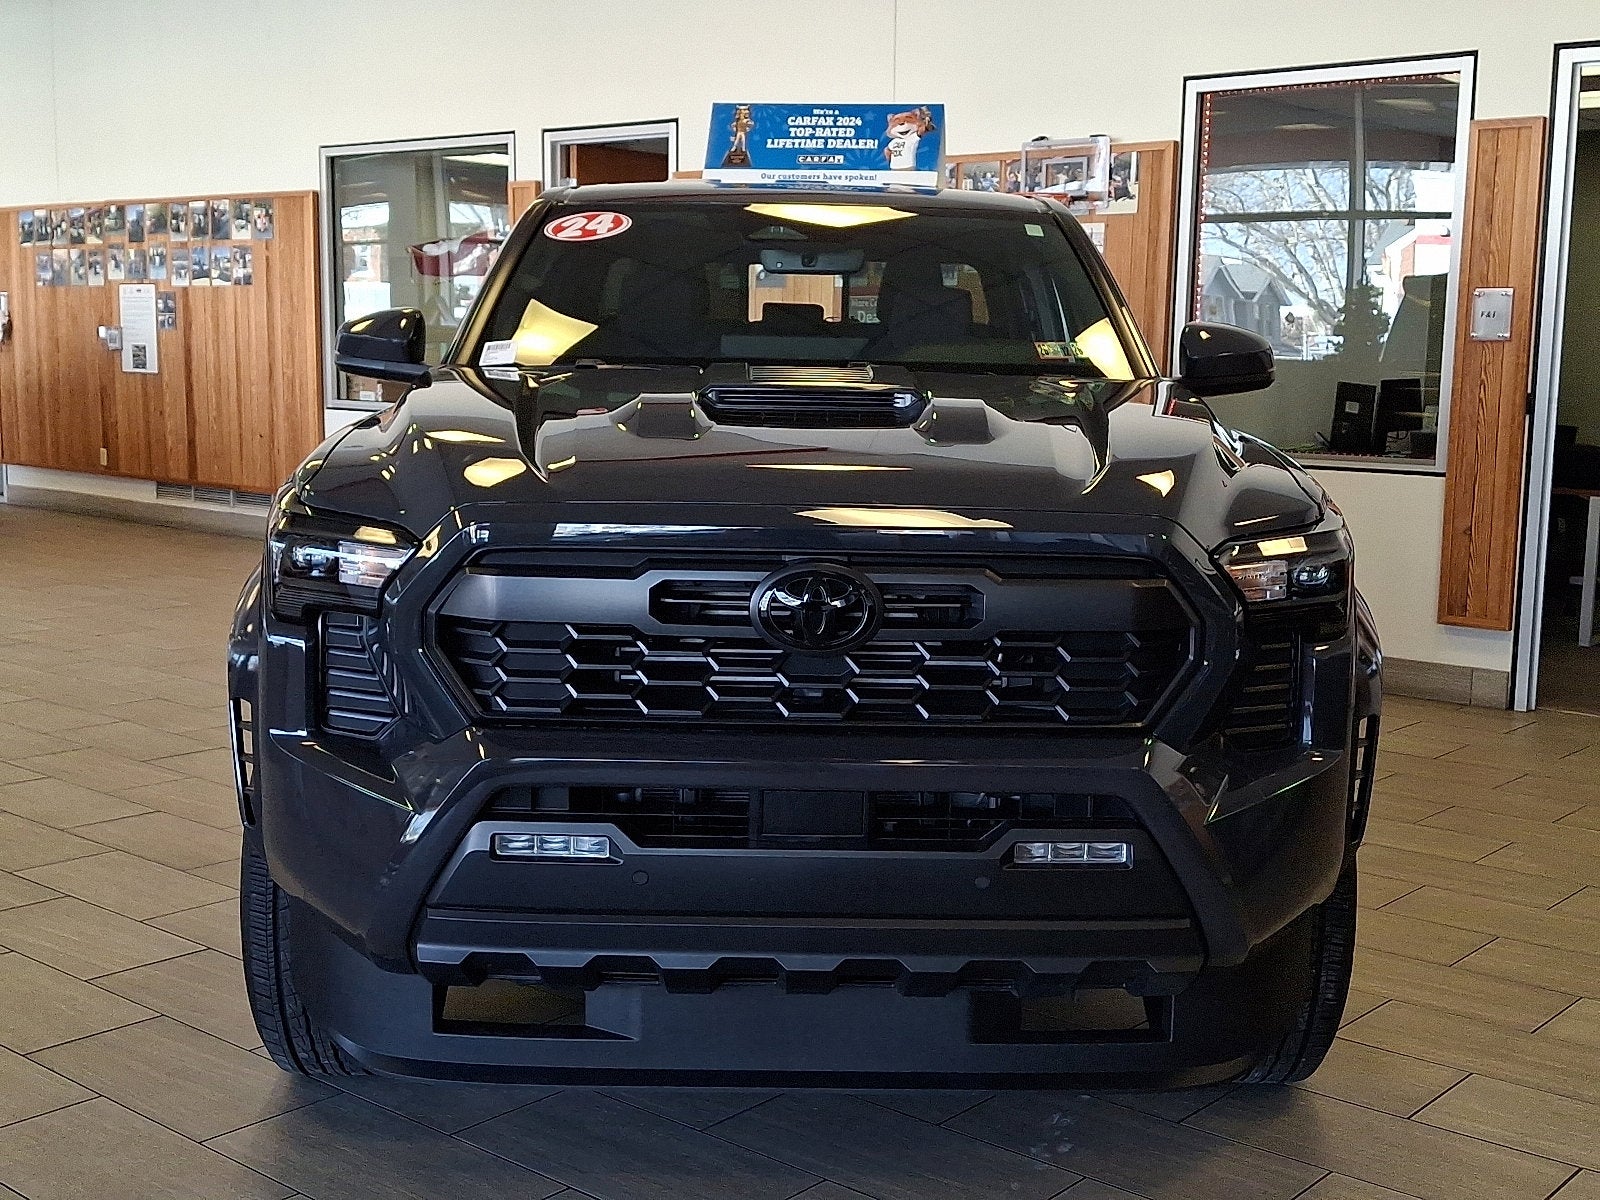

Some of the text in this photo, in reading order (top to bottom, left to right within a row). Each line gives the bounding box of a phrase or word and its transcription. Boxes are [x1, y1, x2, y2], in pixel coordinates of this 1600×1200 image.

[787, 116, 863, 126] CARFAX 2024
[789, 127, 856, 137] TOP-RATED
[766, 138, 879, 149] LIFETIME DEALER!
[797, 155, 844, 164] CARFAX
[760, 172, 775, 180] Our
[823, 172, 844, 180] have
[844, 173, 878, 182] spoken!
[556, 214, 615, 237] 24
